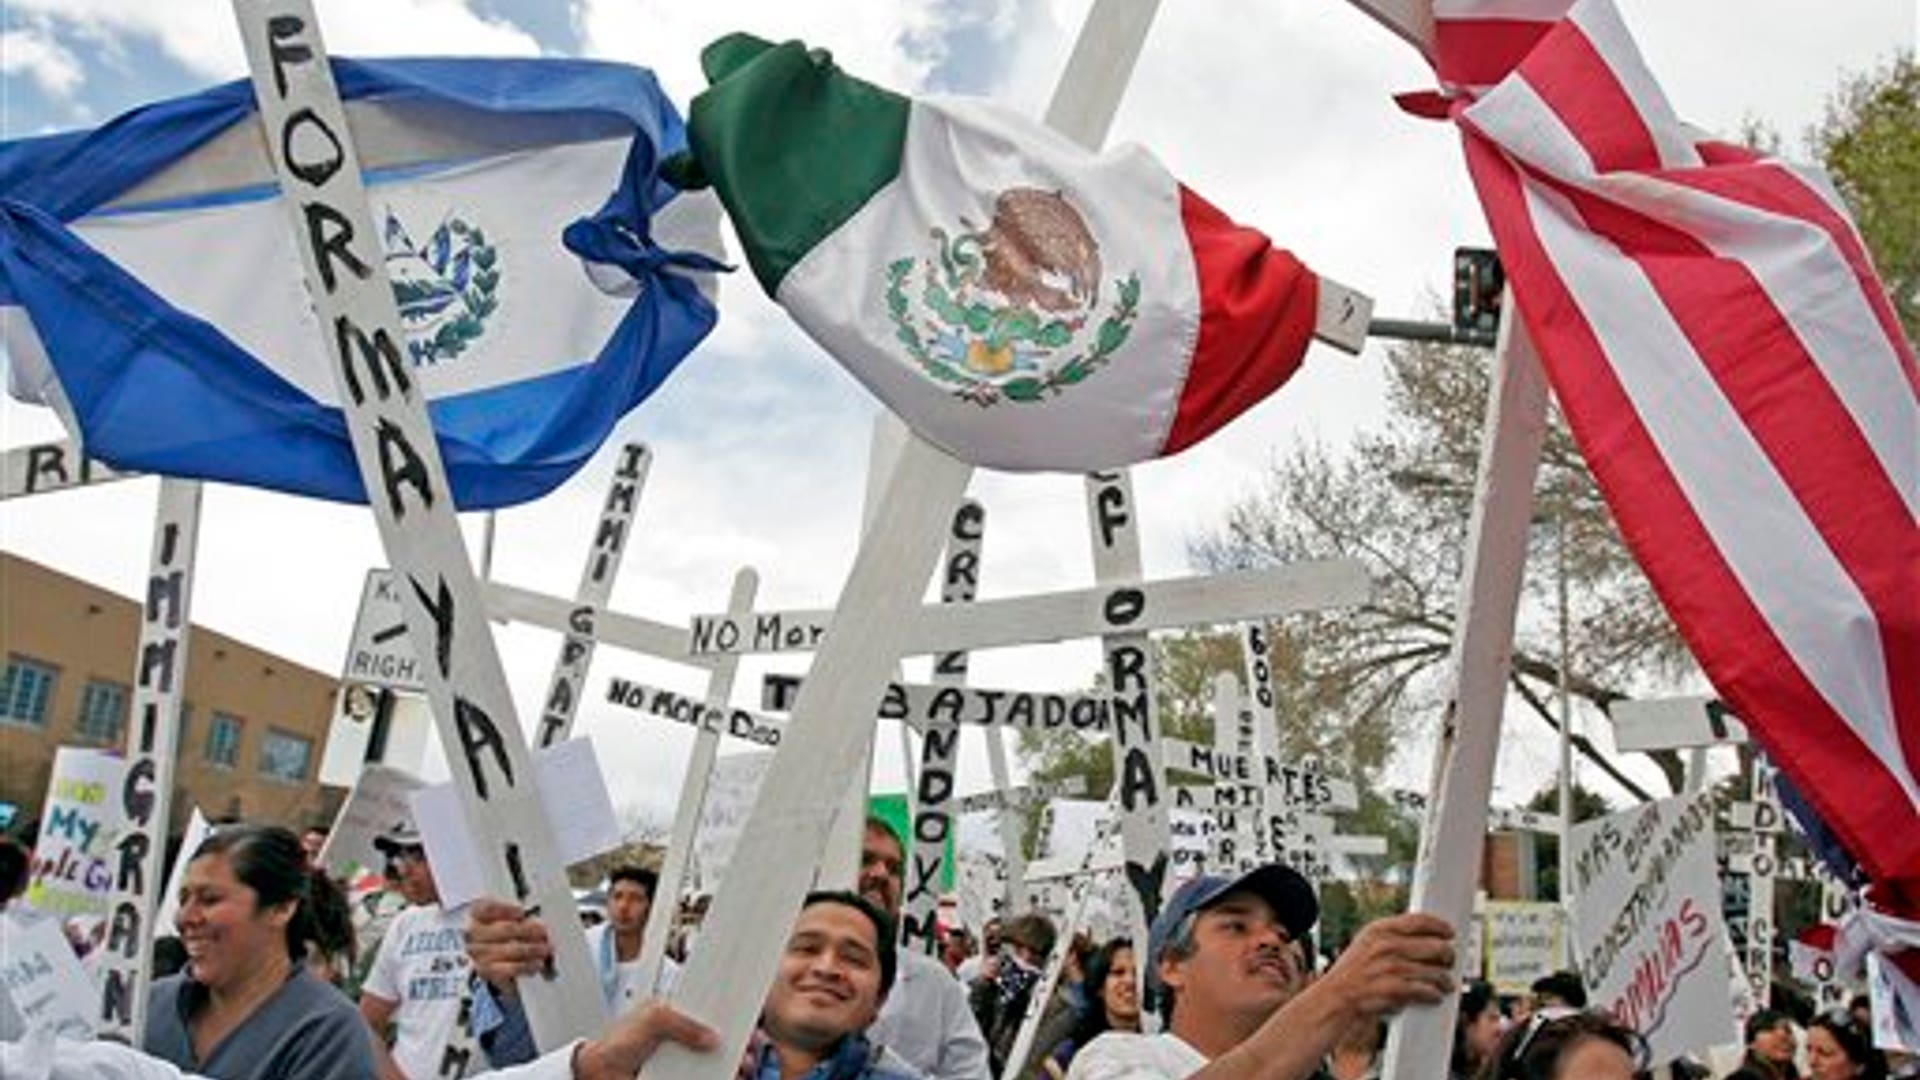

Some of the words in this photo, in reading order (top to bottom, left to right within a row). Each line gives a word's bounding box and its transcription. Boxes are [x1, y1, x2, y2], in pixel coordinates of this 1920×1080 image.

[268, 15, 434, 518] FORMA
[97, 523, 184, 1046] IMMIGRAN
[352, 651, 425, 681] RIGH
[690, 616, 740, 652] NO
[1088, 471, 1158, 812] FORMA
